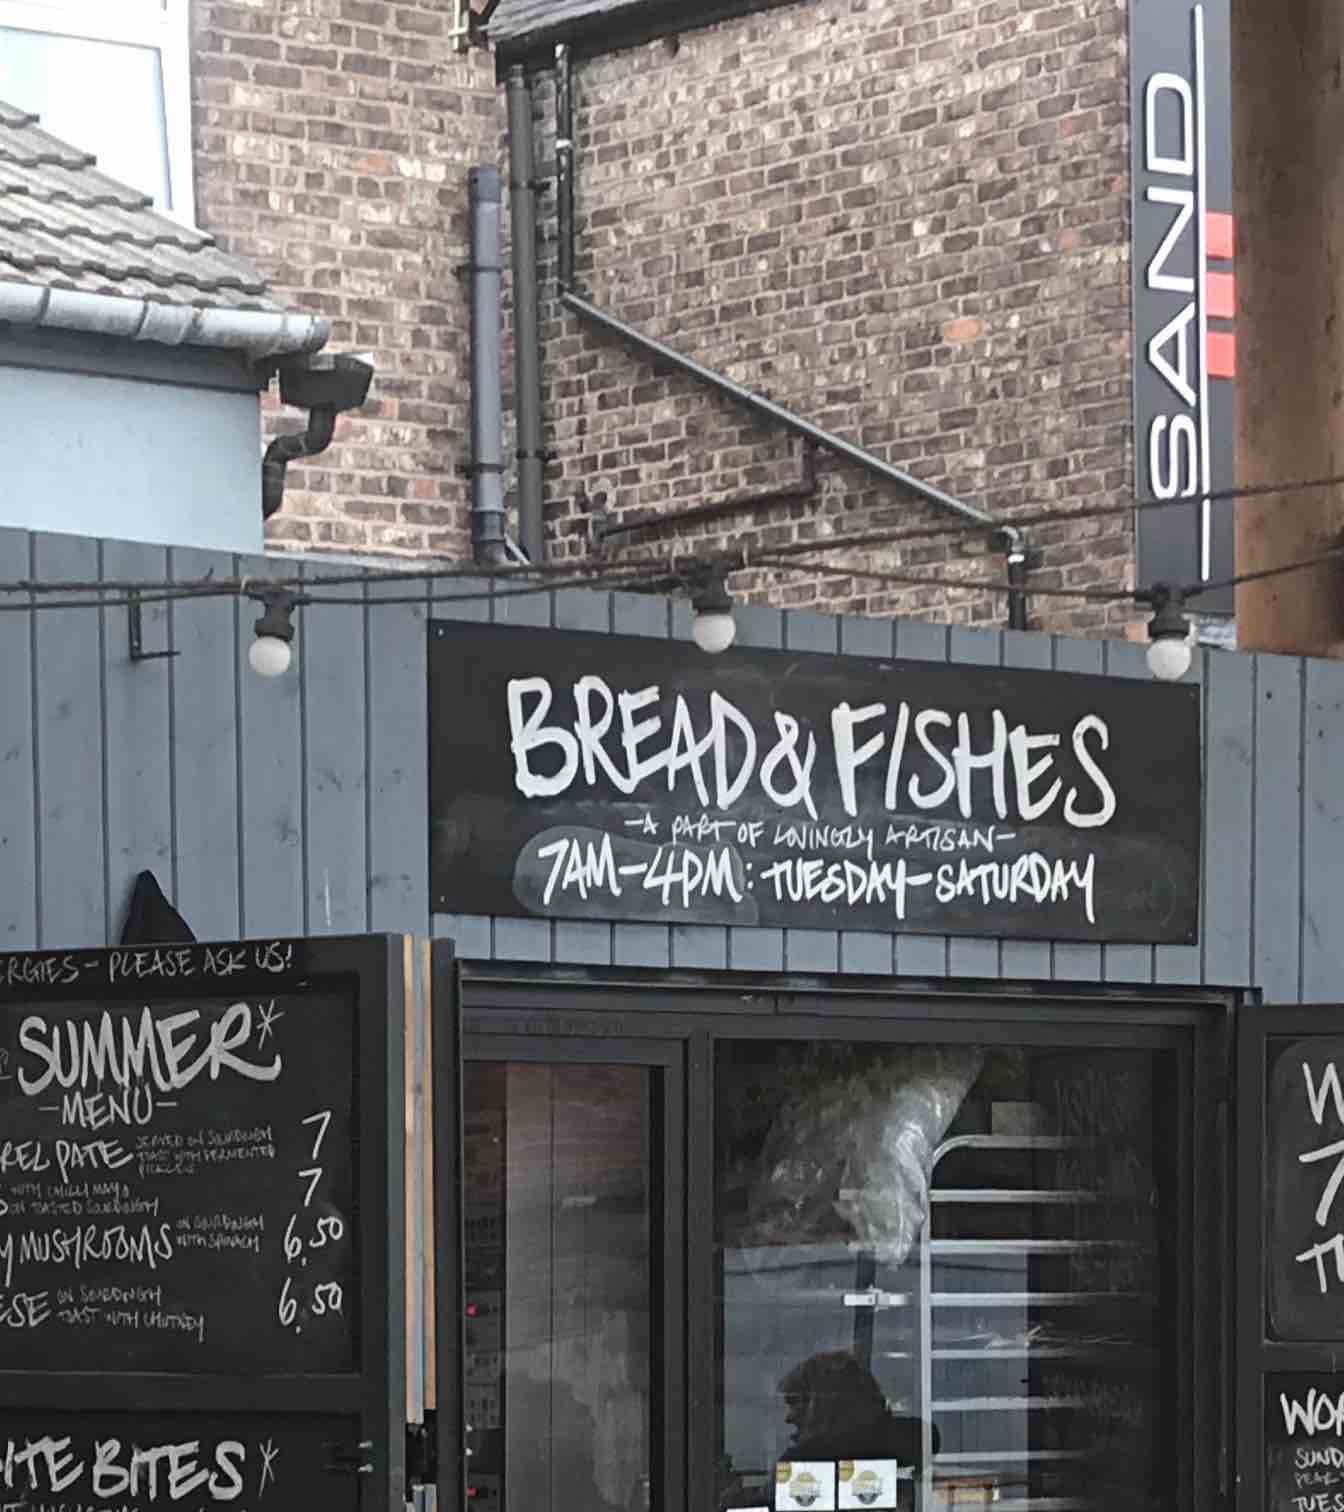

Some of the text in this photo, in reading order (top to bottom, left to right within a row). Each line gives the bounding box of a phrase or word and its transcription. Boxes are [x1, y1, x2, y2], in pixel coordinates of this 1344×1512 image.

[1145, 73, 1197, 500] SAND
[507, 676, 1117, 828] BREAD & FISHES
[672, 816, 737, 845] PART
[737, 822, 764, 846] OF
[773, 824, 874, 858] LOVINGLY
[109, 950, 194, 983] PLEASE
[204, 946, 246, 975] ASK
[256, 942, 293, 973] US!
[302, 1110, 331, 1160] 7
[56, 1139, 134, 1183] PATE
[297, 1167, 323, 1207] 7
[19, 1223, 174, 1269] MUSHROOMS
